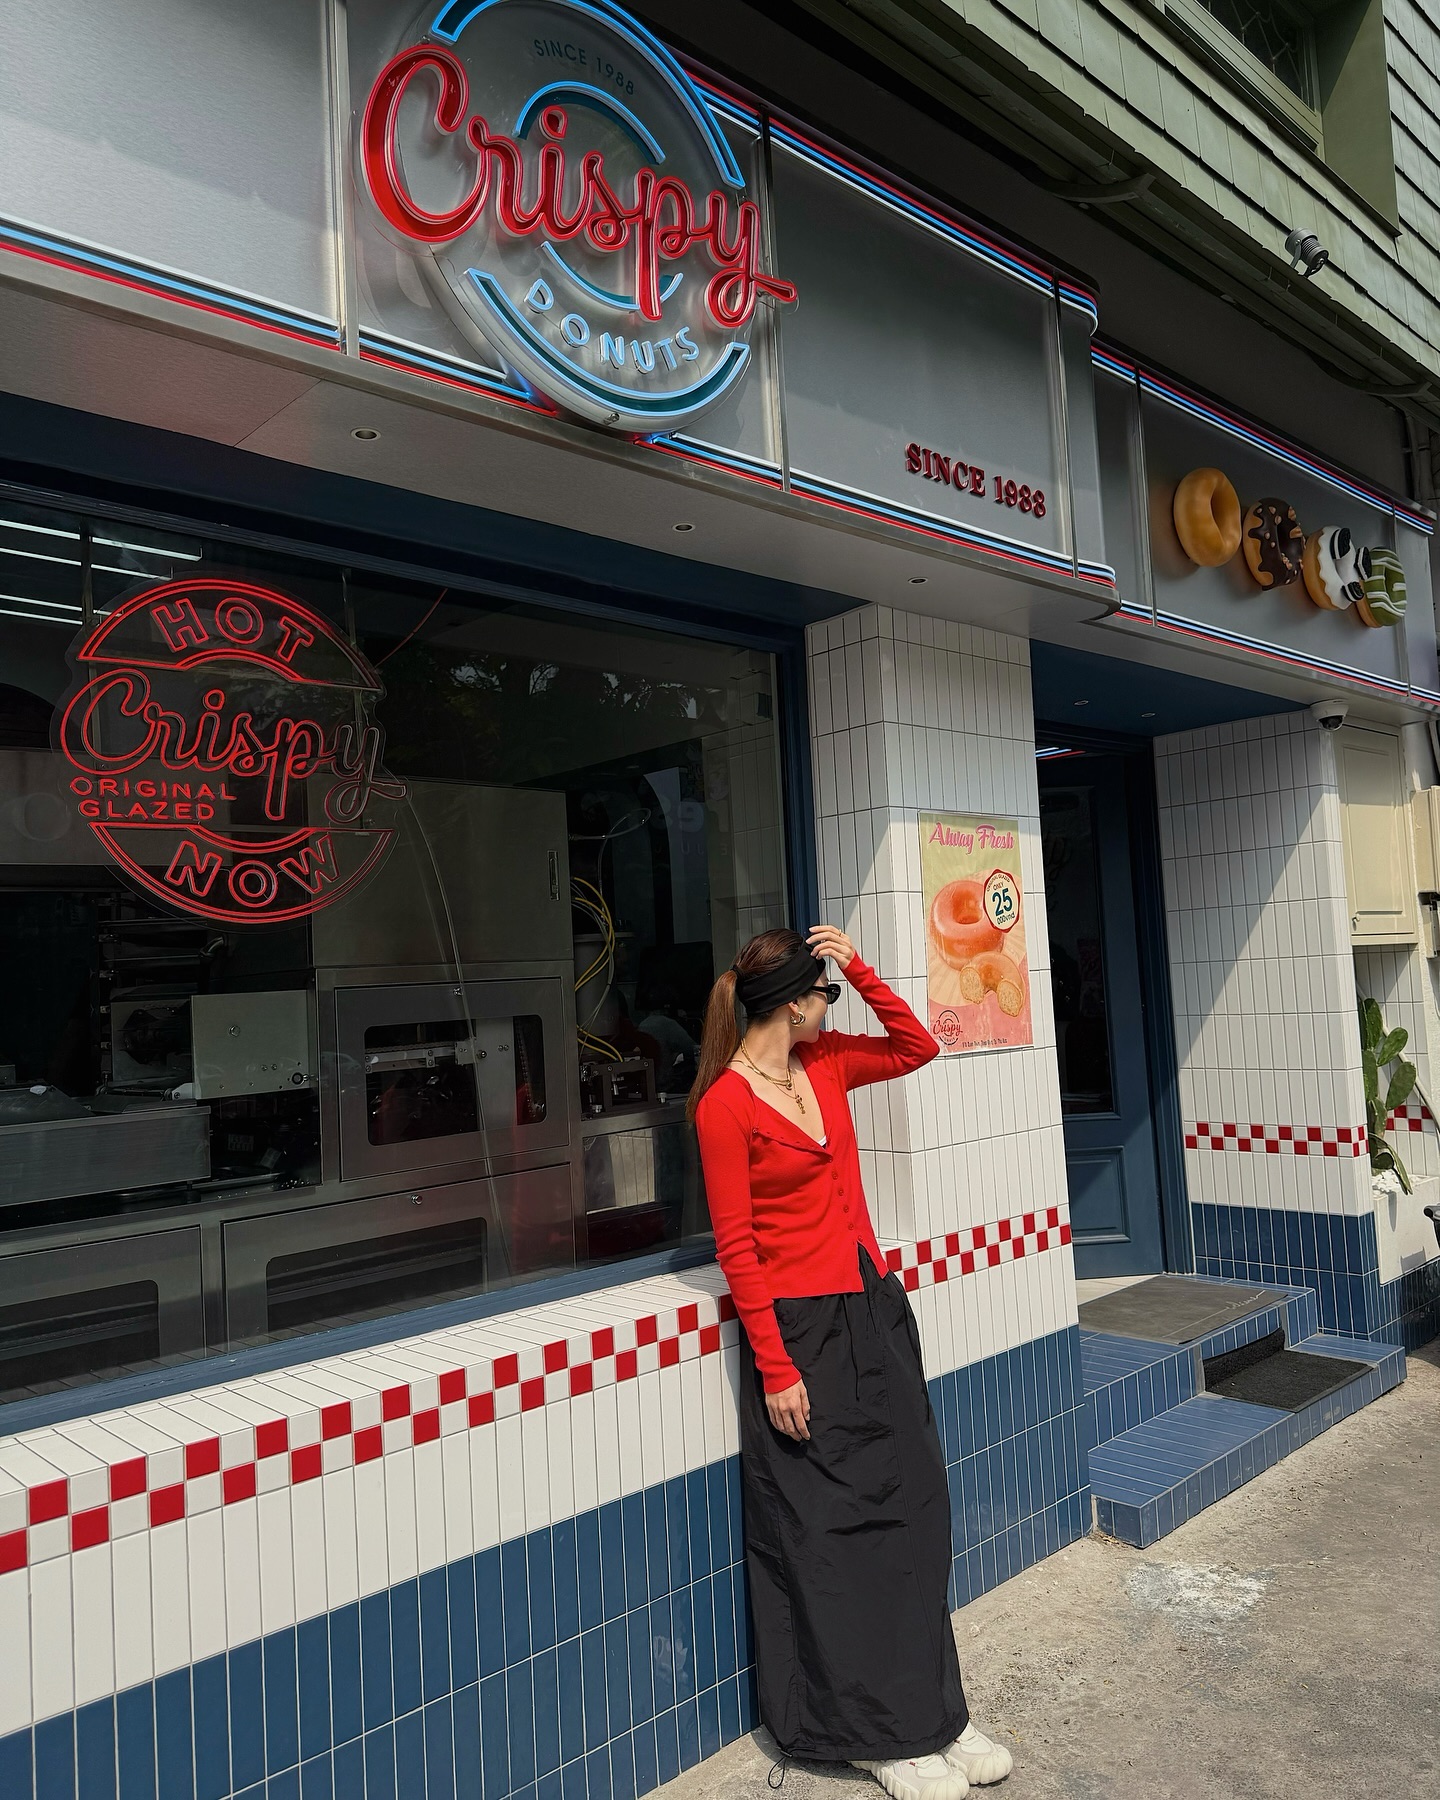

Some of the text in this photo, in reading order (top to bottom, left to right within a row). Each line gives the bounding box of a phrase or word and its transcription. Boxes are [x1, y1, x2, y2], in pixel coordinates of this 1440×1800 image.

[534, 39, 634, 95] SINCE 1988
[361, 44, 797, 328] Crispy
[524, 278, 700, 374] DONUTS
[905, 442, 1046, 518] SINCE 1988
[151, 597, 314, 662] HOT
[60, 668, 406, 824] Crispy
[69, 776, 237, 800] ORIGINAL
[78, 799, 215, 820] GLAZED
[928, 822, 1014, 855] Alway Fresh
[164, 833, 340, 907] NOW
[992, 888, 1013, 916] 25
[933, 1019, 963, 1037] Crispy
